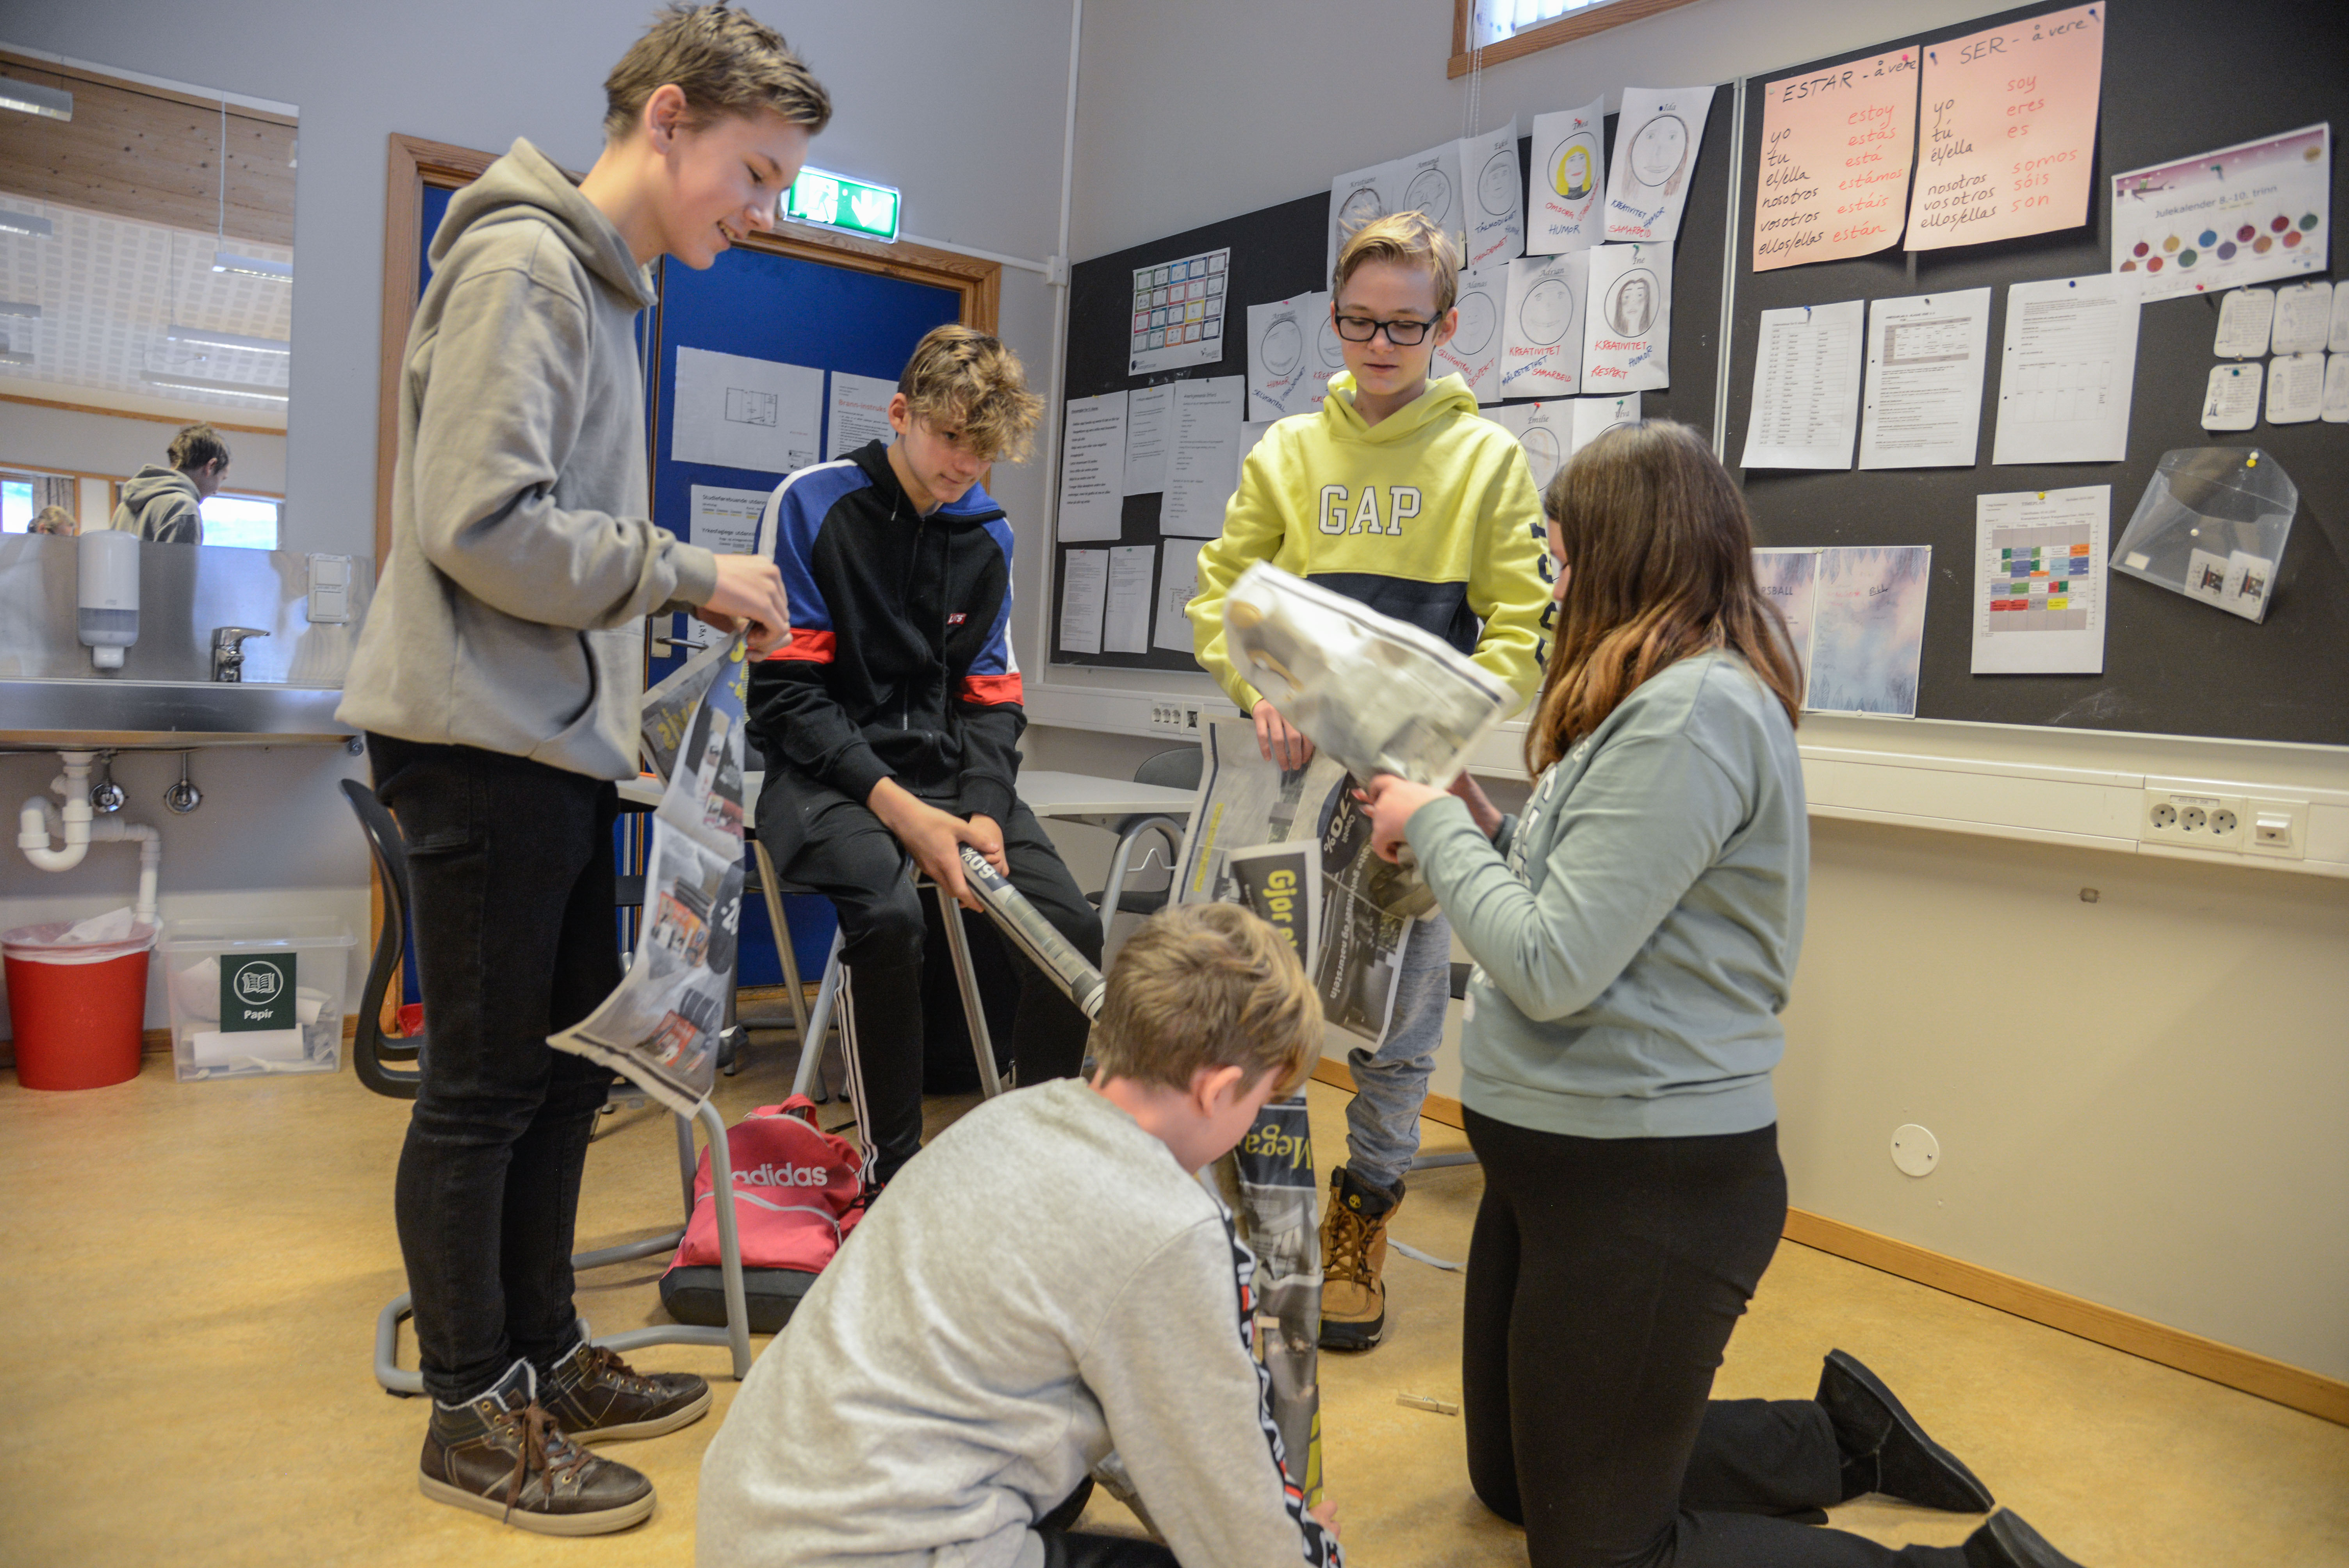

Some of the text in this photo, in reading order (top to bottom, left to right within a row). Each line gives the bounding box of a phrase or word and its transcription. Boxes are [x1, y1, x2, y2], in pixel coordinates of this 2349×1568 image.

[1961, 36, 2007, 64] SER
[2033, 25, 2044, 42] å
[2049, 20, 2087, 38] vere
[1782, 70, 1853, 103] ESTAR
[1875, 60, 1884, 77] å
[1888, 59, 1917, 73] vere
[2007, 76, 2036, 94] soy
[1848, 104, 1894, 125] estoy
[1934, 97, 1954, 127] yo
[2007, 97, 2045, 116] eres
[1769, 128, 1790, 155] yo
[1848, 123, 1896, 146] estás
[2007, 124, 2029, 139] es
[1846, 146, 1883, 168] está
[2012, 150, 2078, 174] somos
[1839, 169, 1902, 191] estámos
[1928, 174, 1987, 196] nosotros
[1763, 187, 1819, 209] nosotros
[1837, 192, 1888, 214] estáis
[1924, 186, 1994, 210] vosotros
[2012, 193, 2050, 213] son
[2155, 200, 2216, 218] Julekalender
[2253, 186, 2277, 197] trinn
[1545, 202, 1574, 219] OMSORG
[1611, 200, 1647, 219] KREATIVITET
[1921, 206, 1997, 232] ellos/ellas
[1549, 225, 1580, 235] HUMOR
[1608, 225, 1651, 238] SAMARBEID
[1761, 211, 1819, 232] vosotros
[1833, 220, 1886, 243] están
[1759, 230, 1823, 257] ellos/ellas
[1539, 268, 1565, 277] Adrian
[1509, 345, 1561, 356] KREATIVITET
[1595, 340, 1647, 351] KREATIVITET
[1629, 345, 1652, 368] HUMOR
[1591, 365, 1629, 380] RESPEKT
[1527, 415, 1549, 424] Emilie
[1319, 485, 1421, 536] GAP
[1324, 788, 1352, 853] -70%
[961, 847, 999, 879] -60%
[731, 1162, 828, 1187] adidas
